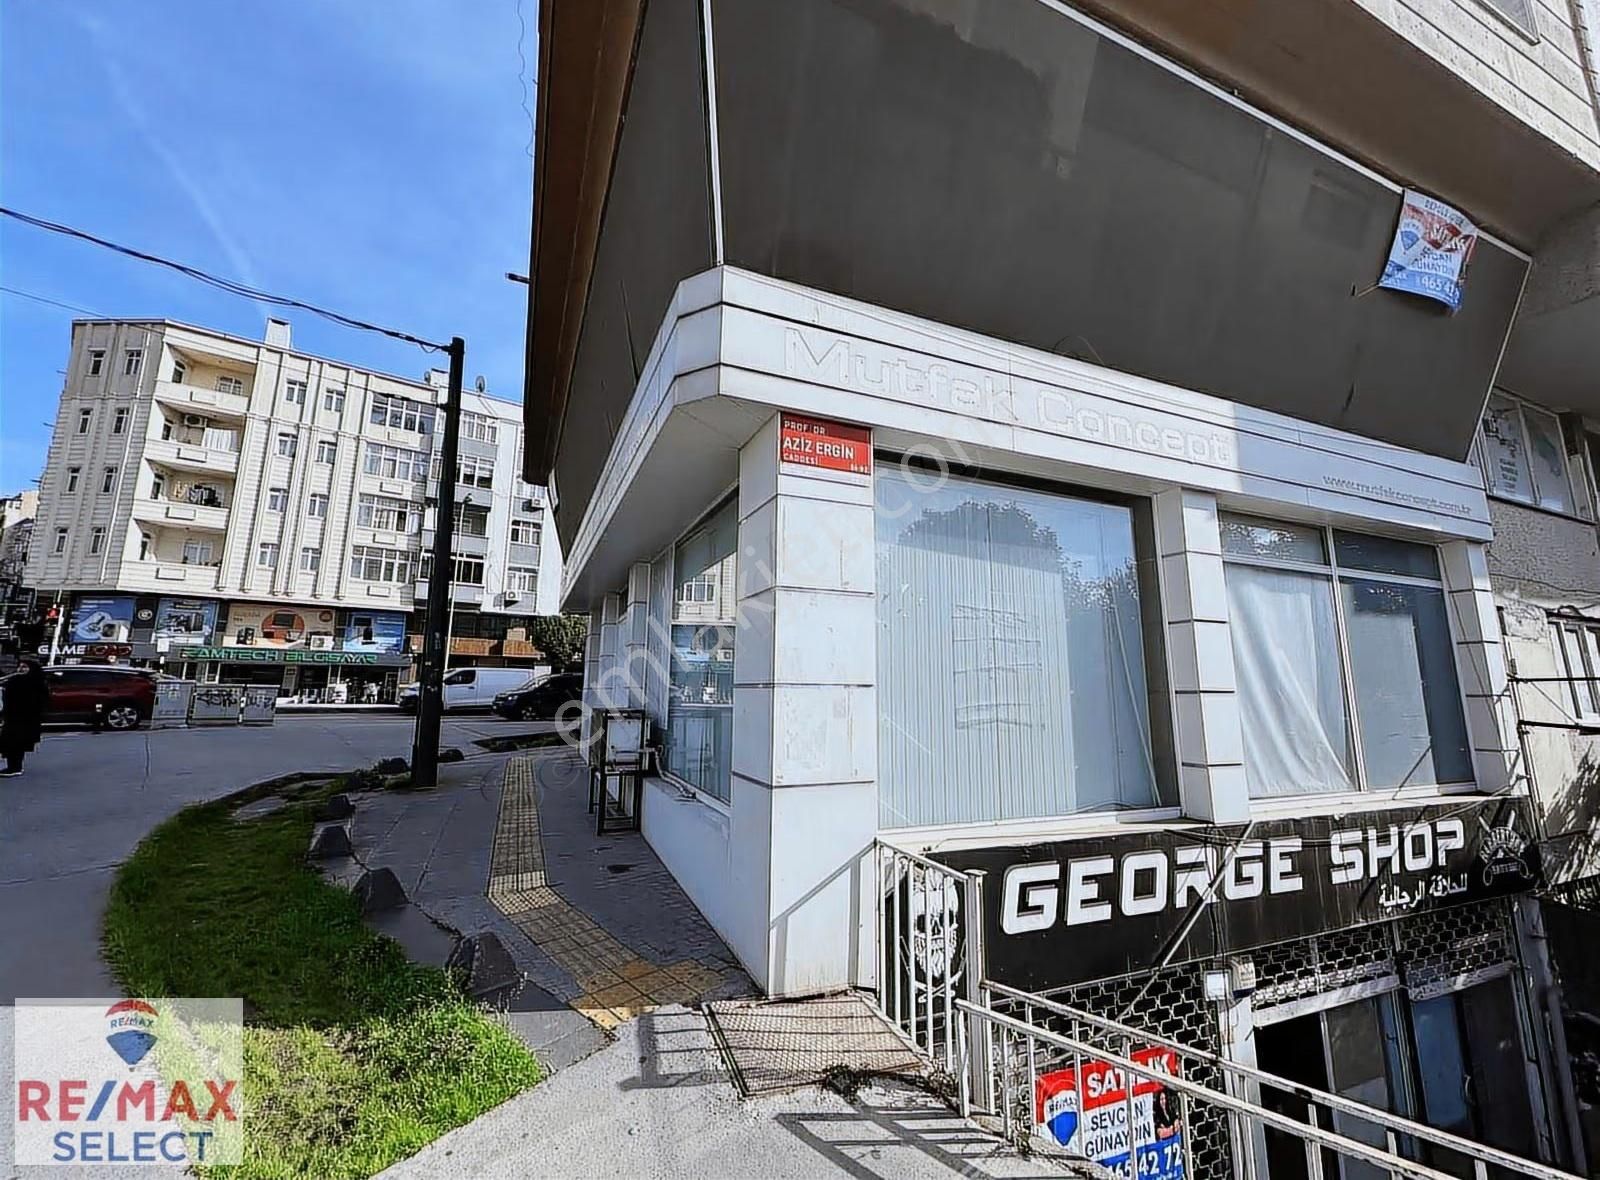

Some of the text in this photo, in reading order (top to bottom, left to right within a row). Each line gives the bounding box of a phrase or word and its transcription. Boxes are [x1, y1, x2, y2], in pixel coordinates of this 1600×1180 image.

[784, 326, 1234, 465] Mutfak Concept
[783, 436, 854, 460] AZİZ ERGİN
[1001, 837, 1303, 935] GEORGE
[1330, 819, 1465, 885] SHOP
[1090, 1101, 1145, 1132] SEVCN
[1138, 1151, 1160, 1176] 42
[1163, 1142, 1182, 1167] 72
